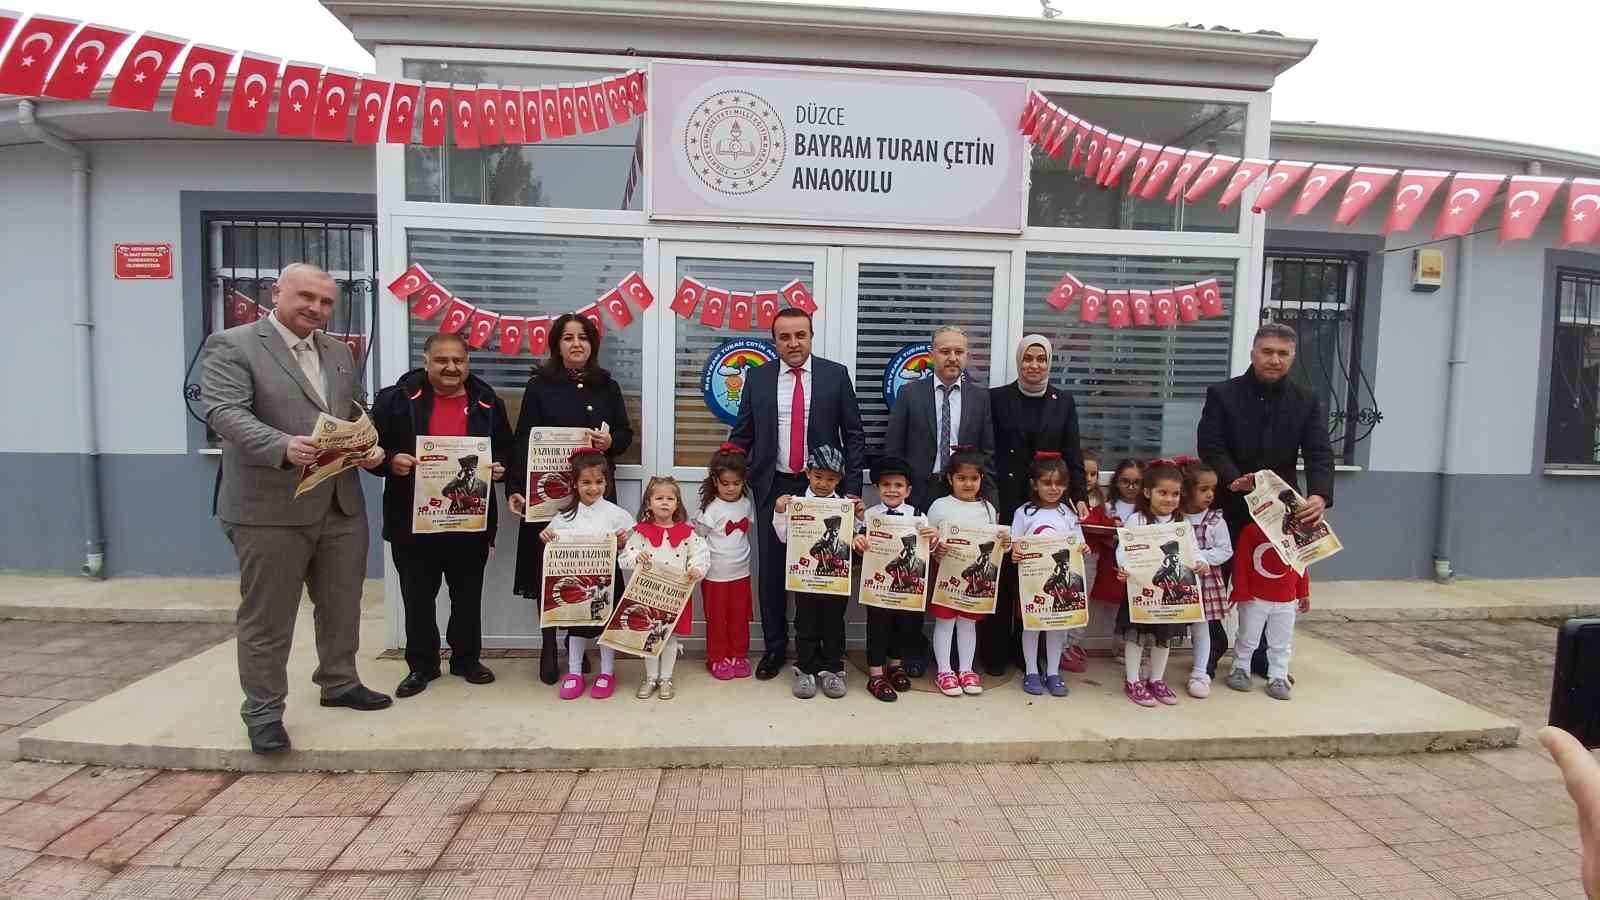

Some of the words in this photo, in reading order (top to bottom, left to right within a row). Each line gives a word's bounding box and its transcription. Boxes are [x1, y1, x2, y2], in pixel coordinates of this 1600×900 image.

[795, 102, 845, 126] DÜZCE
[794, 132, 872, 160] BAYRAM
[876, 136, 938, 163] TURAN
[943, 138, 994, 170] ÇETİN
[792, 167, 893, 193] ANAOKULU
[549, 550, 579, 559] YAZIYOR
[582, 550, 611, 559] YAZIYOR
